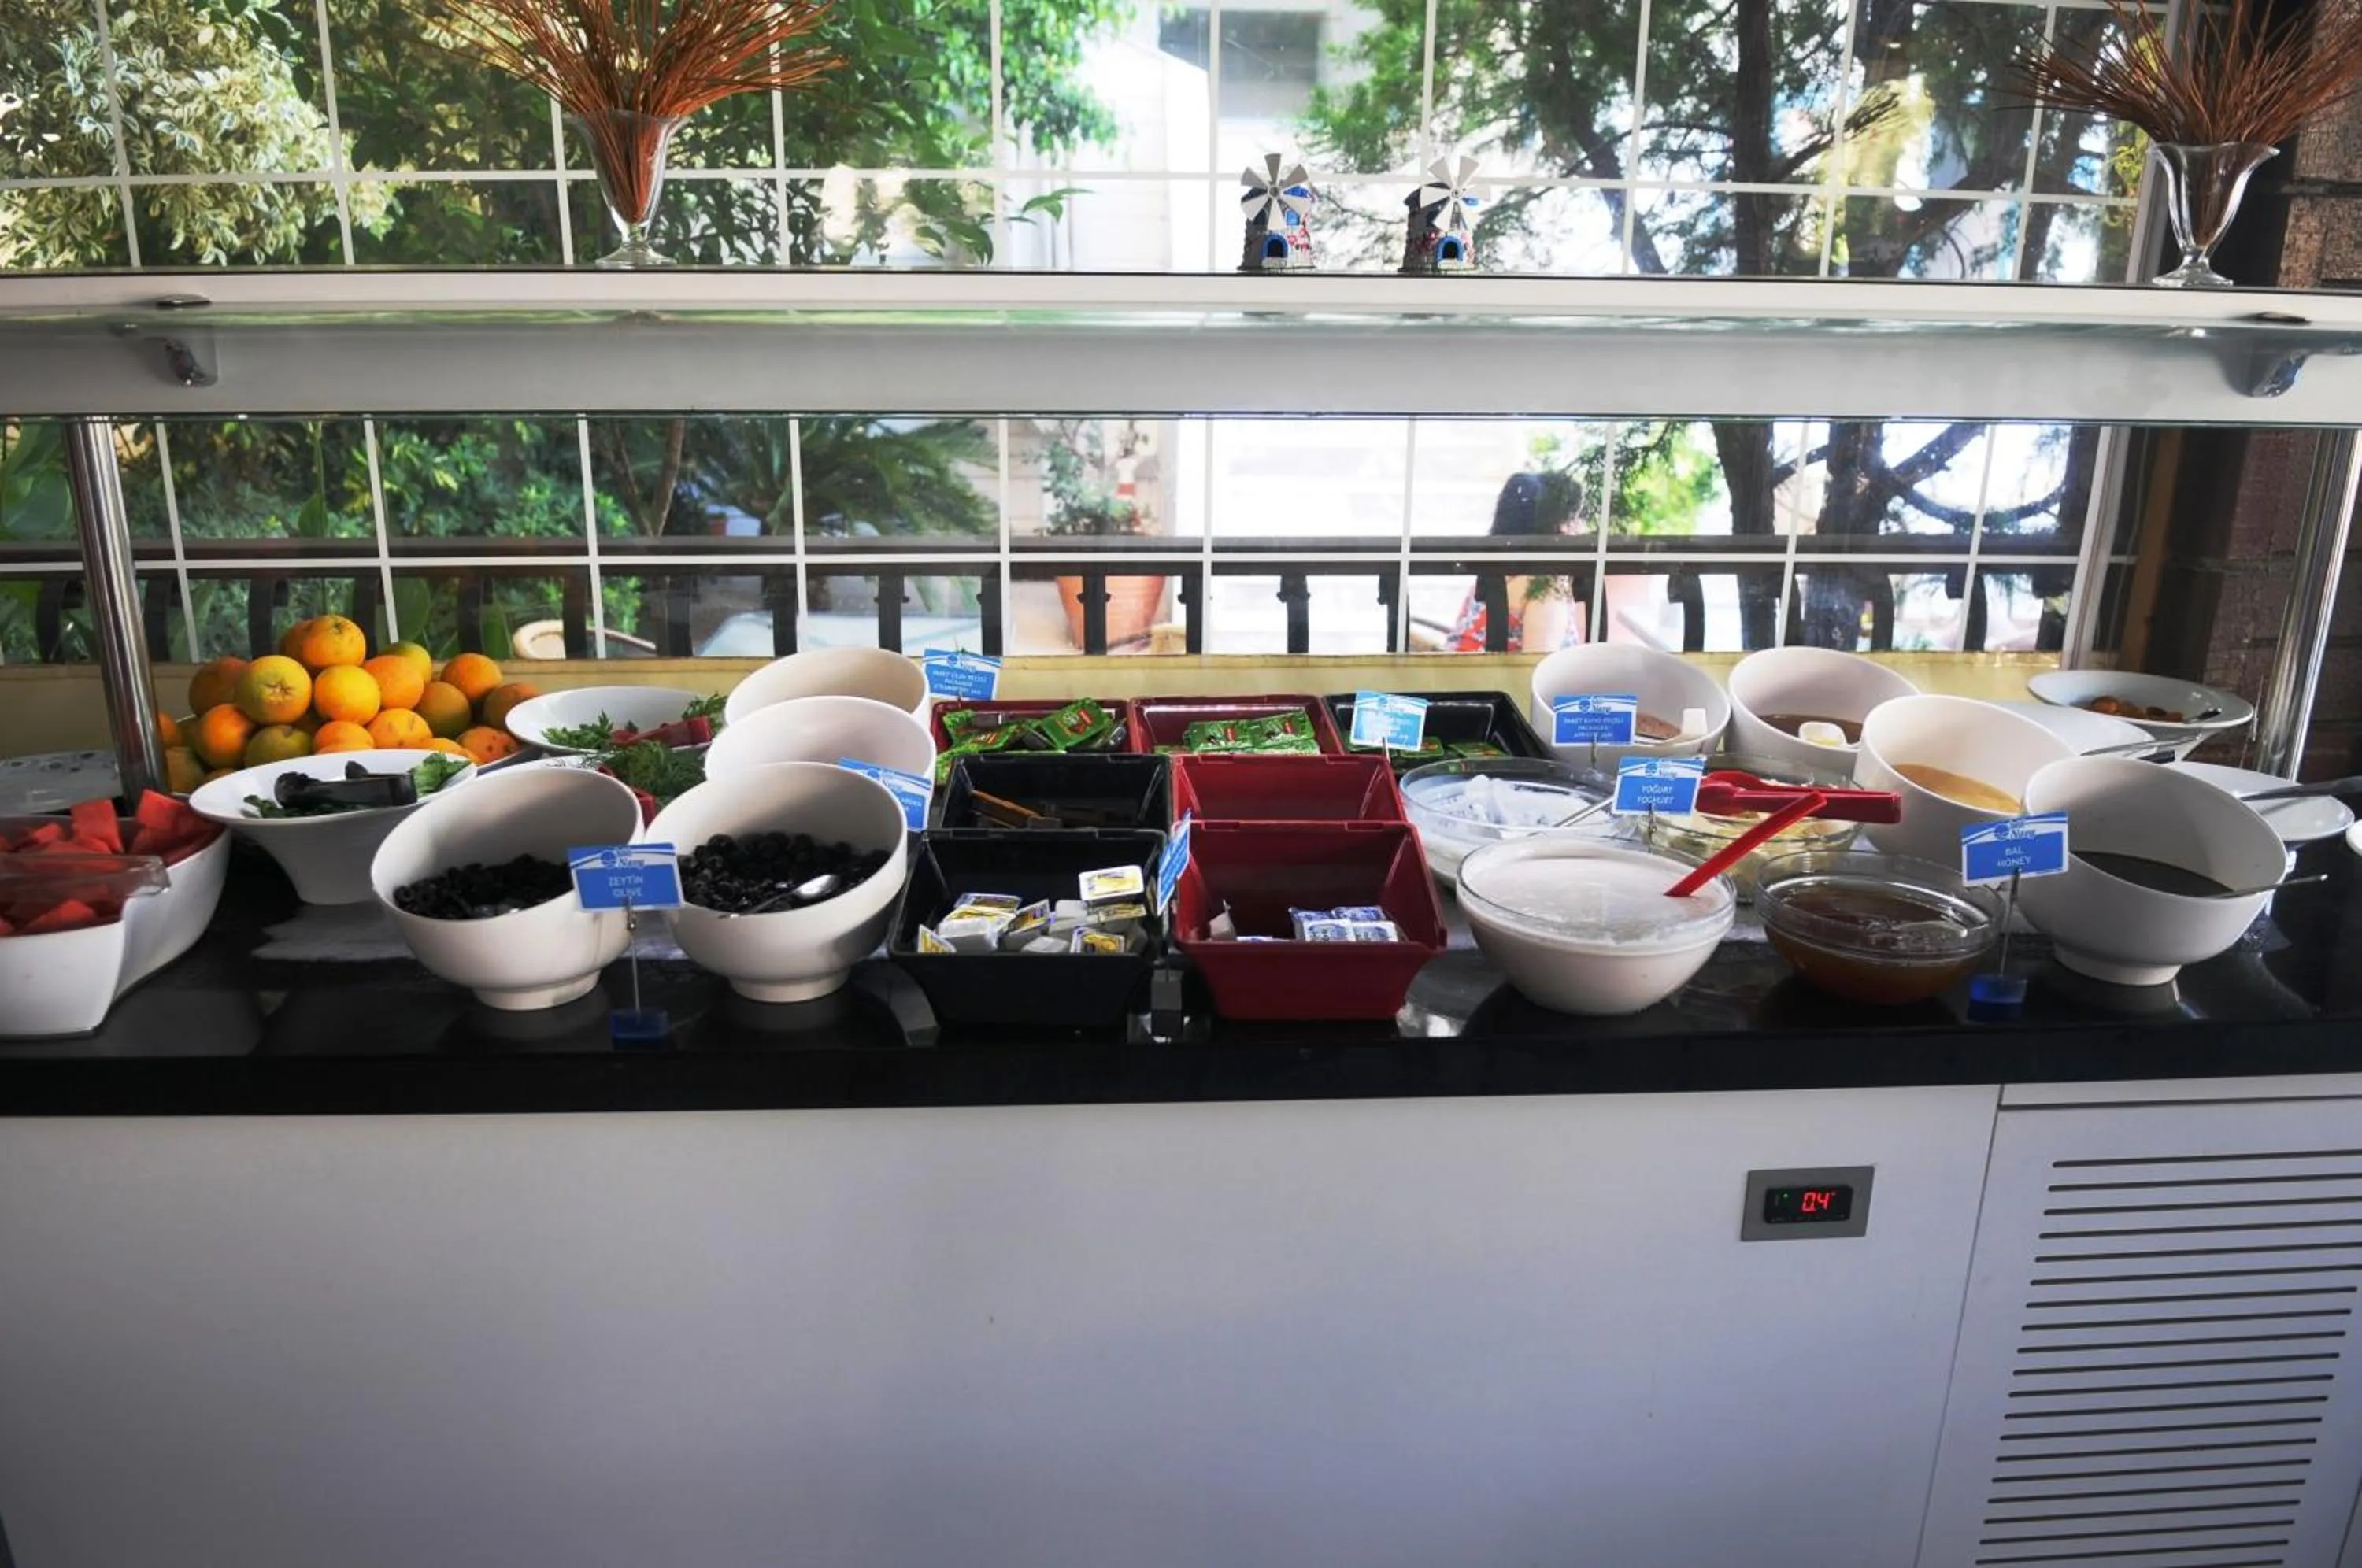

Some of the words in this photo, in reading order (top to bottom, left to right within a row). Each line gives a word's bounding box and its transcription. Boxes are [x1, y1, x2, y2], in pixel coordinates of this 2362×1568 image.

[1642, 783, 1673, 794] YOĞURT
[2005, 845, 2024, 856] BAL
[1997, 856, 2031, 867] HONEY
[608, 875, 644, 887] ZEYTİN
[612, 887, 643, 898] OLIVE
